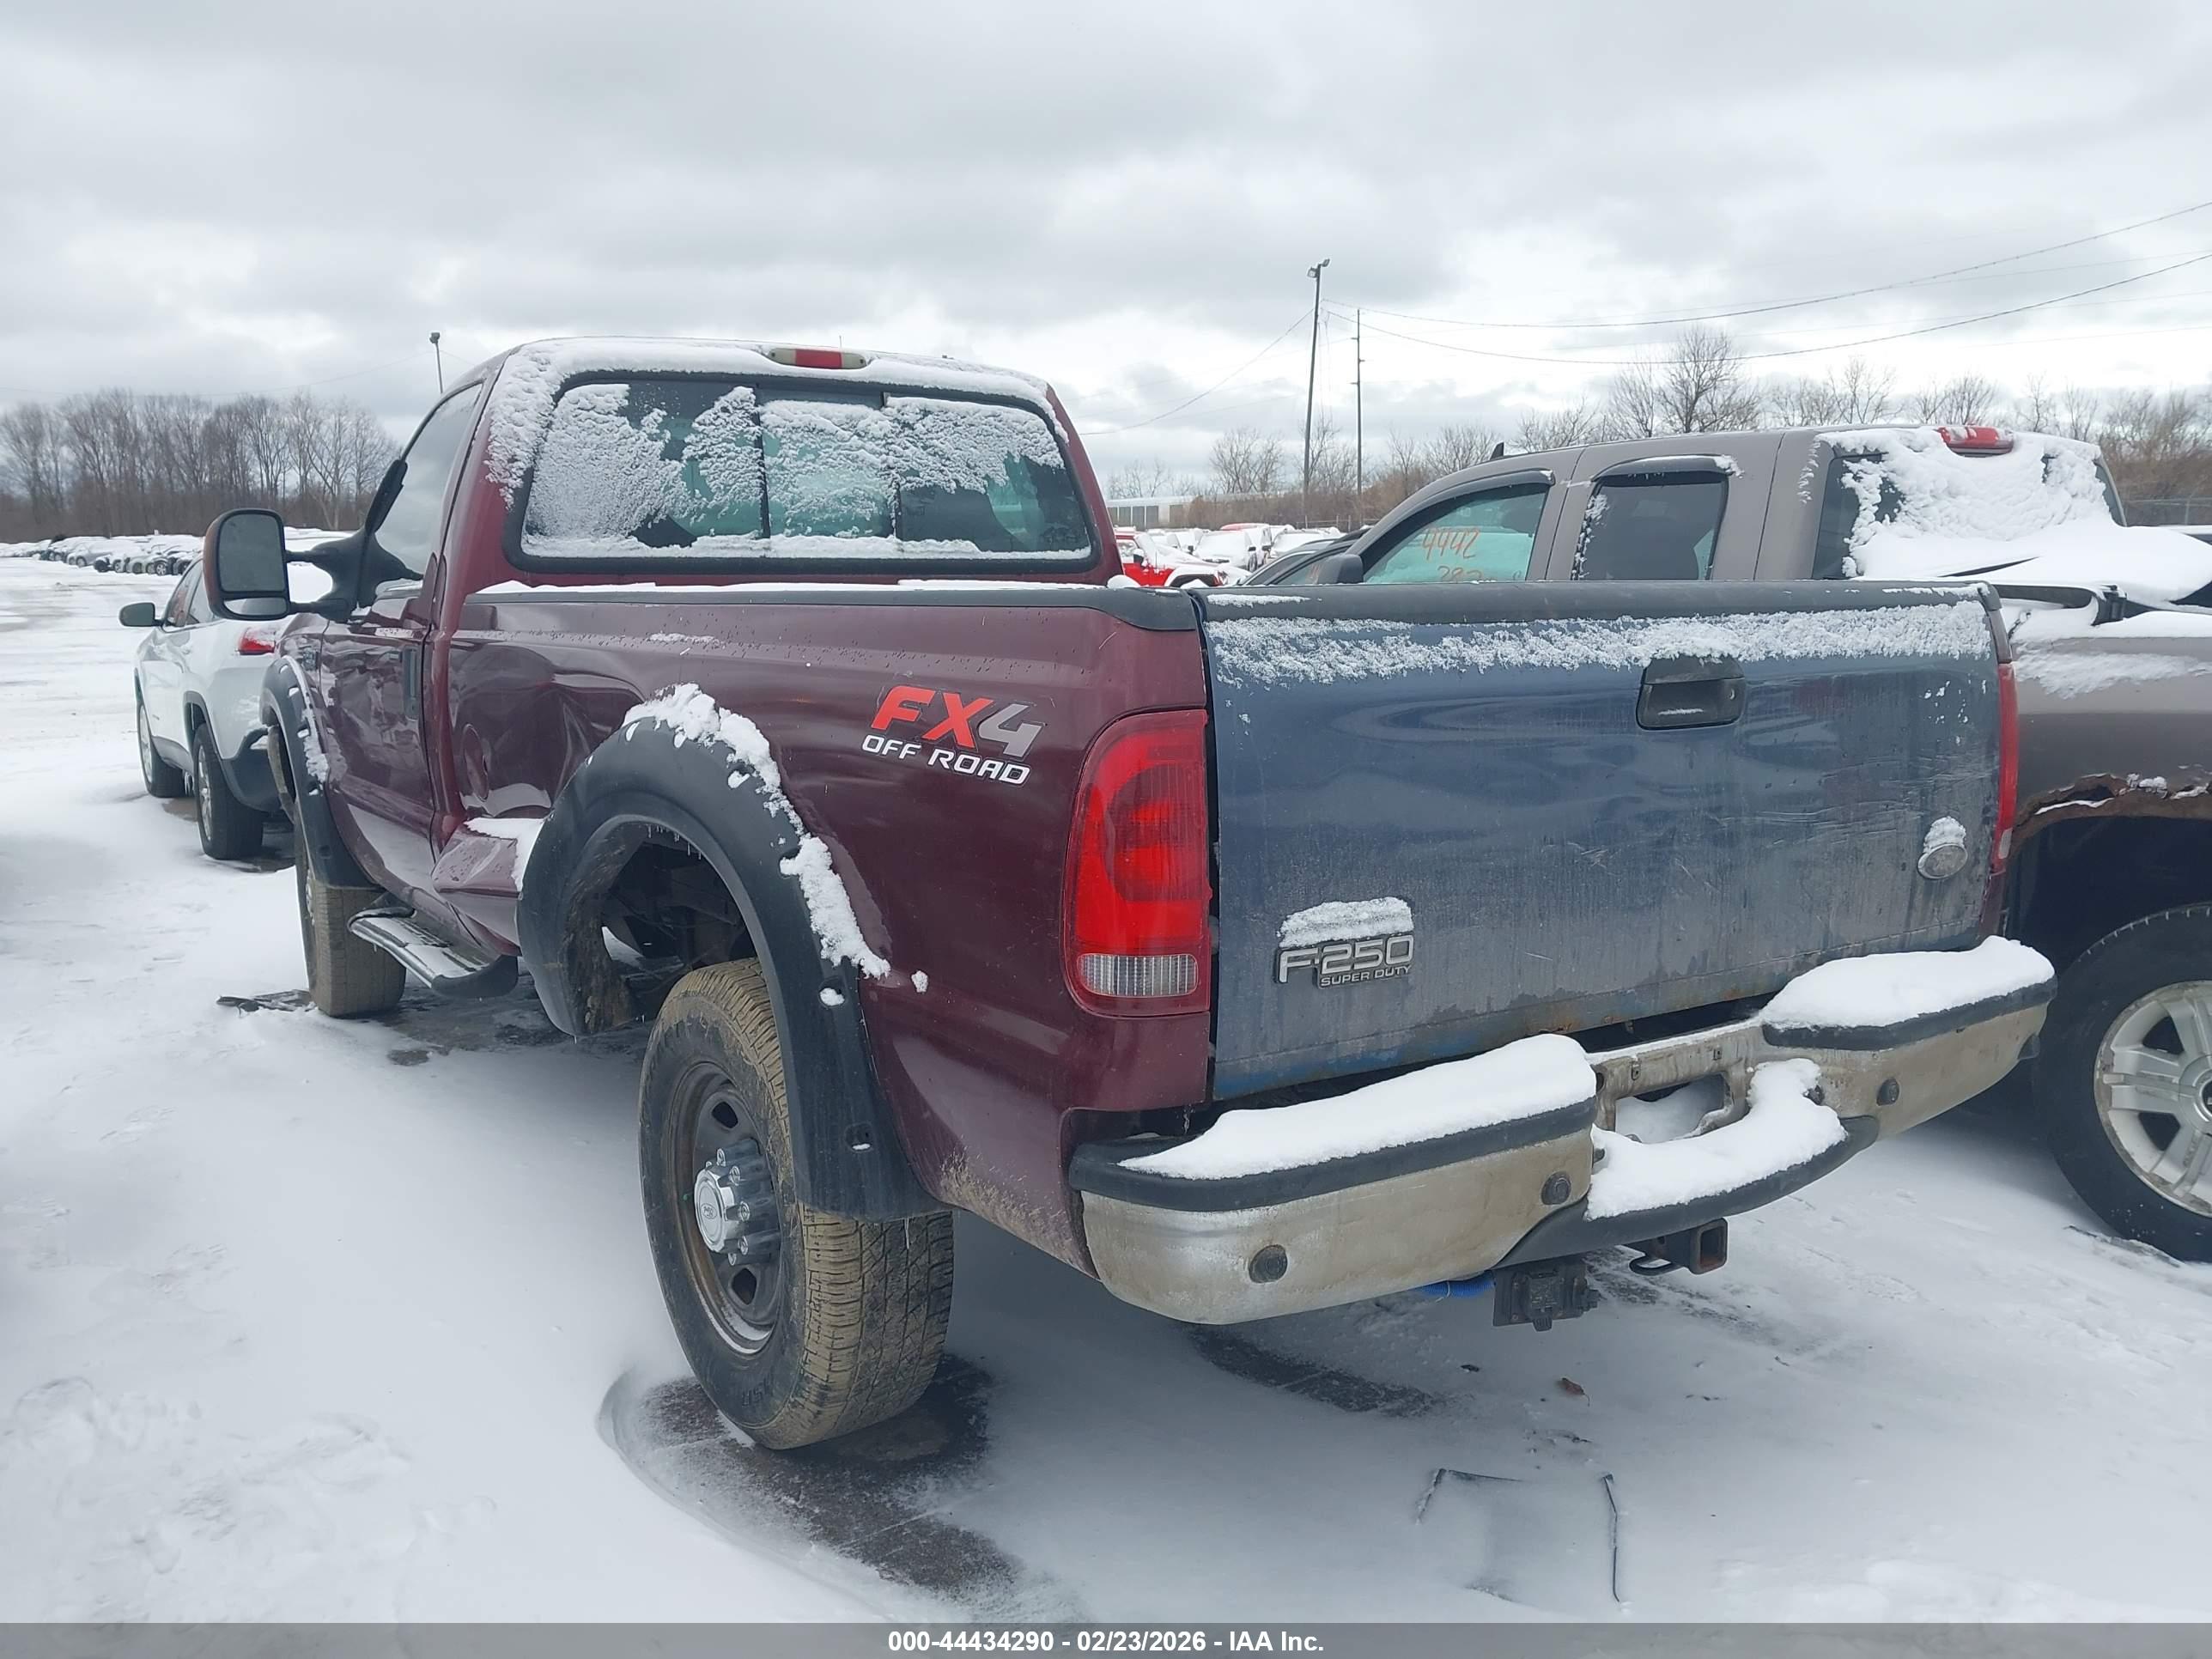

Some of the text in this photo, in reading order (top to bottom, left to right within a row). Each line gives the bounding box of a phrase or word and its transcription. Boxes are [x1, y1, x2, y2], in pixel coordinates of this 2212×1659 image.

[871, 685, 1043, 757] FX4
[861, 734, 1030, 785] OFF ROAD
[1321, 965, 1411, 987] SUPER DUTY
